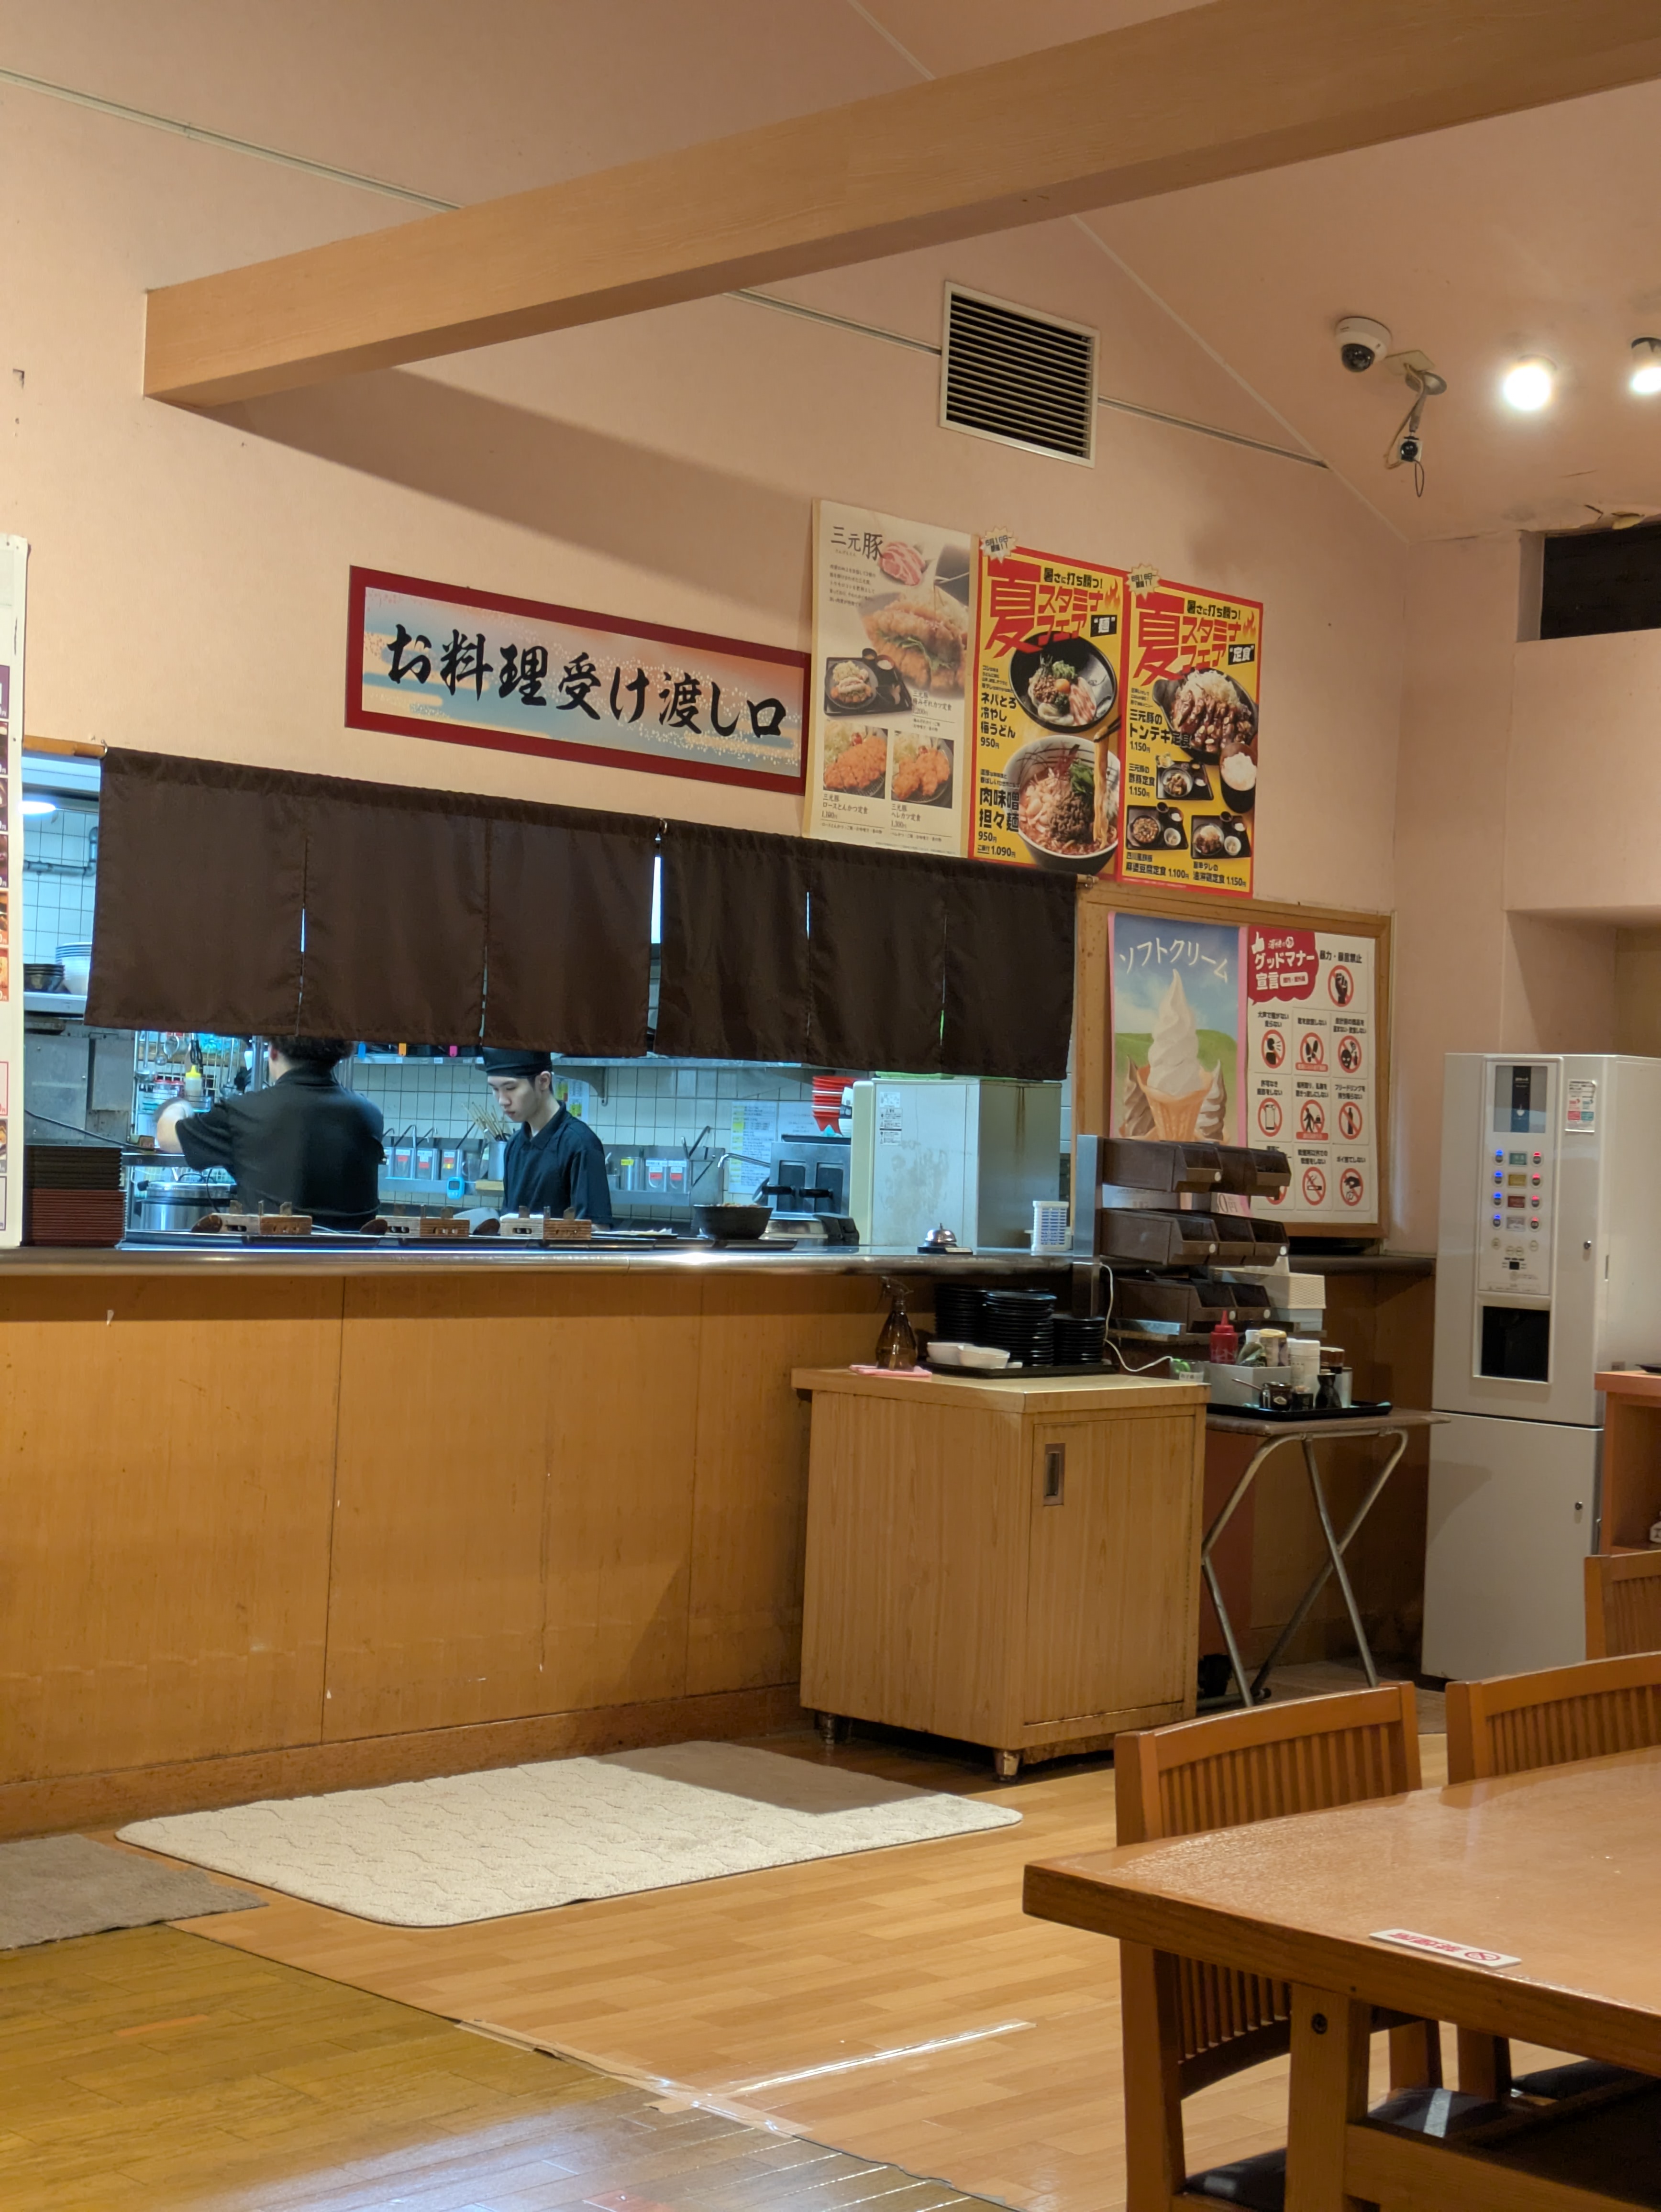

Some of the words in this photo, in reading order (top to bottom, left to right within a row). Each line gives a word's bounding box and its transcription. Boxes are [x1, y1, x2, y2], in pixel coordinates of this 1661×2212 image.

[830, 526, 884, 561] 三元豚
[984, 556, 1043, 658] 夏
[1038, 585, 1104, 614] スタミナ
[1036, 613, 1087, 646] フェア
[1182, 616, 1241, 644] スタミナ
[1132, 590, 1185, 686] 夏
[1180, 643, 1227, 674] フェア
[387, 624, 787, 738] お料理受け渡し口
[981, 692, 1017, 709] ネバとろ
[981, 707, 1007, 722] 冷やし
[1129, 709, 1163, 725] 三元豚の
[981, 721, 1016, 739] 梅うどん
[980, 737, 999, 749] 950円
[1129, 741, 1151, 753] 1,150円
[1129, 763, 1150, 773] 三元豚の
[823, 794, 839, 802] 三元豚
[980, 787, 1019, 811] 肉味噌
[1129, 786, 1150, 798] 1,150円
[823, 802, 868, 814] ロースとんかつ定食
[891, 804, 908, 812] 三元豚
[891, 812, 921, 822] ヘレカツ定食
[978, 831, 997, 843] 950円
[991, 845, 1016, 858] 1,090円
[1168, 868, 1189, 879] 1,100円
[1226, 876, 1246, 887] 1,150円
[1119, 937, 1228, 983] ソフトクリーム
[1255, 950, 1315, 970] グッドマナー
[1319, 950, 1362, 964] 暴力・暴言禁止
[1256, 972, 1279, 990] 宣言
